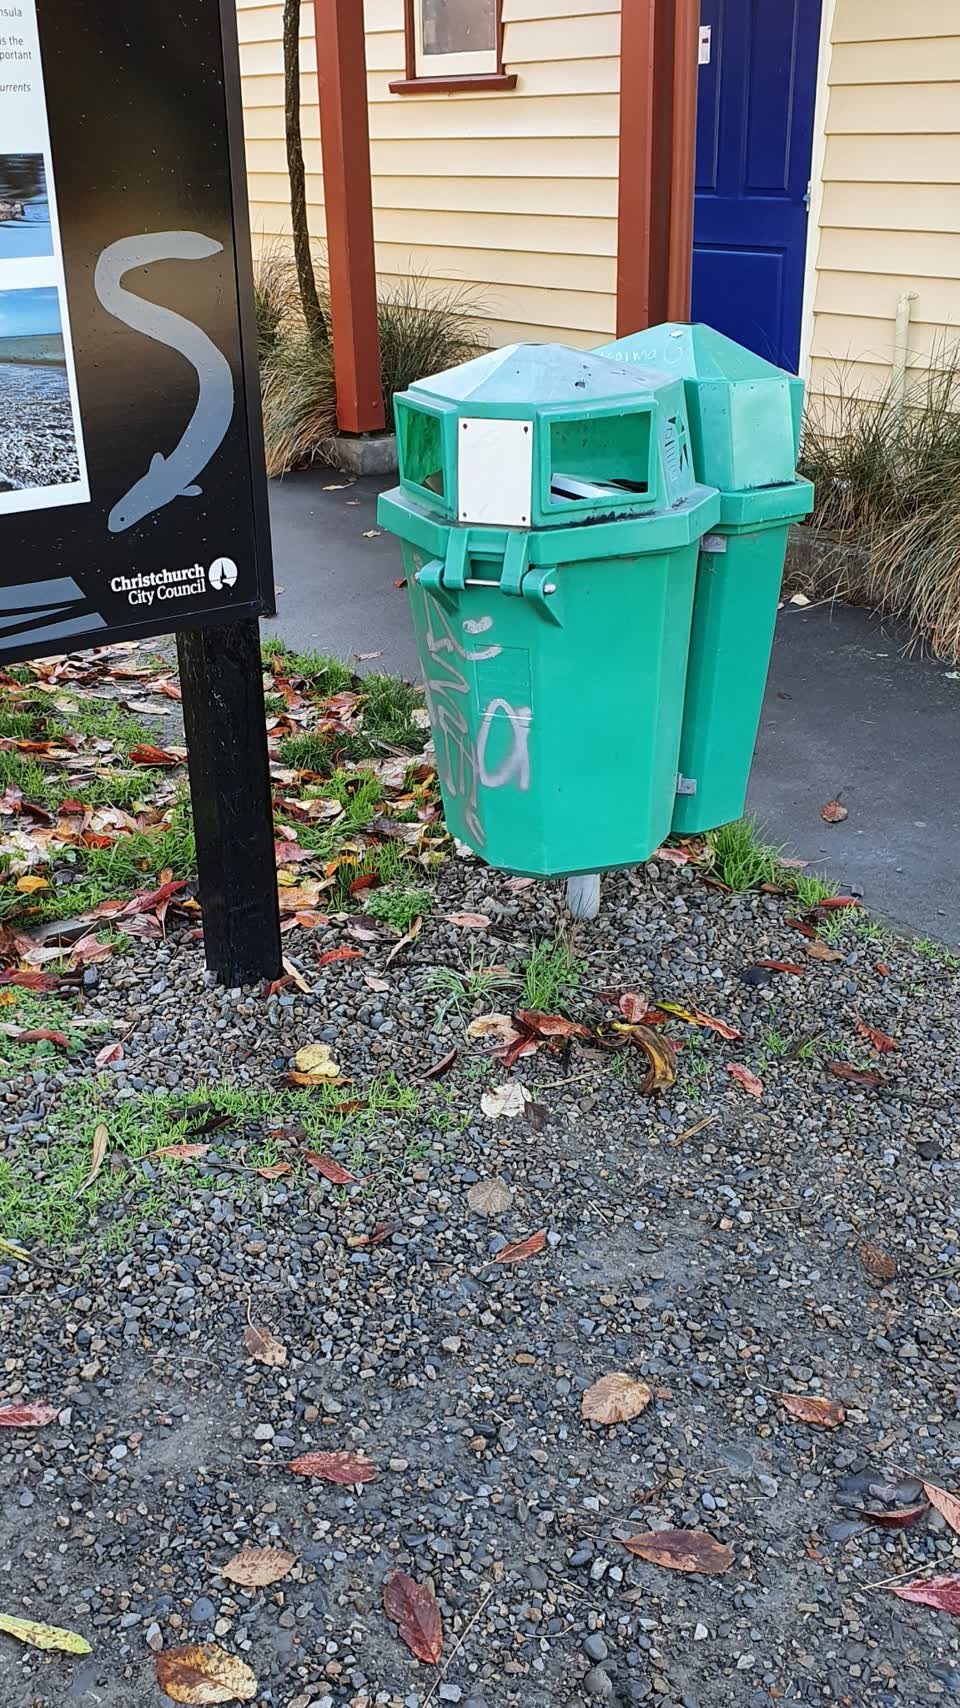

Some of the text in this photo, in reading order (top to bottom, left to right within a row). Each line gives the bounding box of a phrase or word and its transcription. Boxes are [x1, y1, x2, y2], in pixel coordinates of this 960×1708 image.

[8, 35, 24, 46] the
[110, 563, 206, 592] Christchurch
[127, 578, 207, 606] City Council
